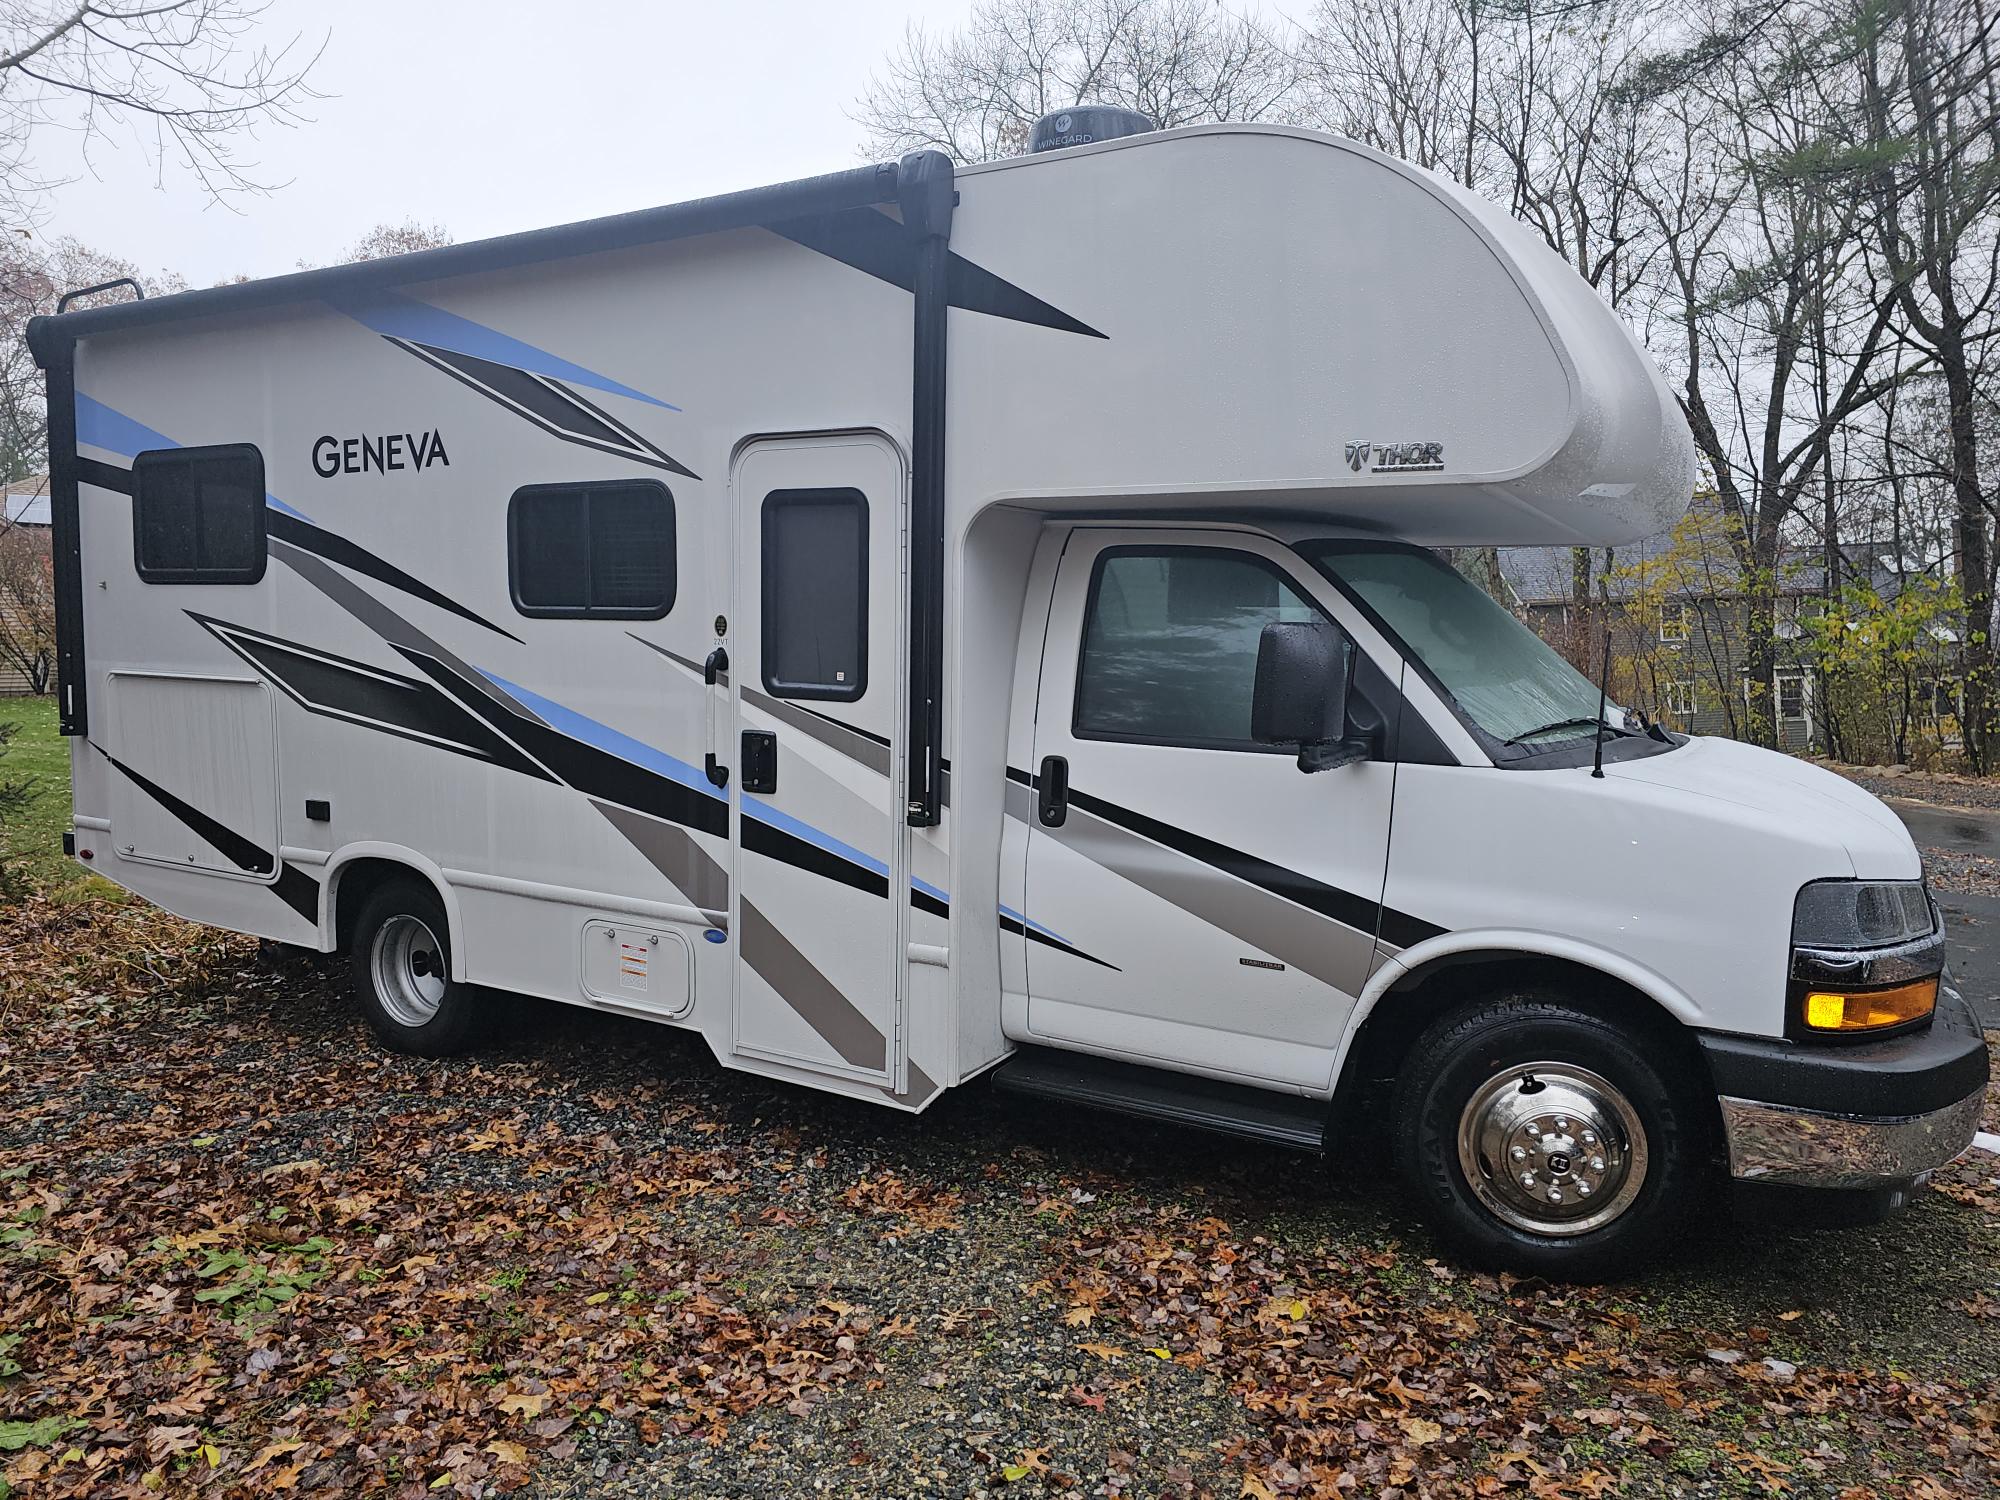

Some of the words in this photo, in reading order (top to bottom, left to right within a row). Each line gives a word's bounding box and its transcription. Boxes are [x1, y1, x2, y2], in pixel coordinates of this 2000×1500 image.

[1038, 134, 1093, 150] WINEGARD
[312, 427, 450, 478] GENEVA
[1373, 441, 1444, 466] THOR
